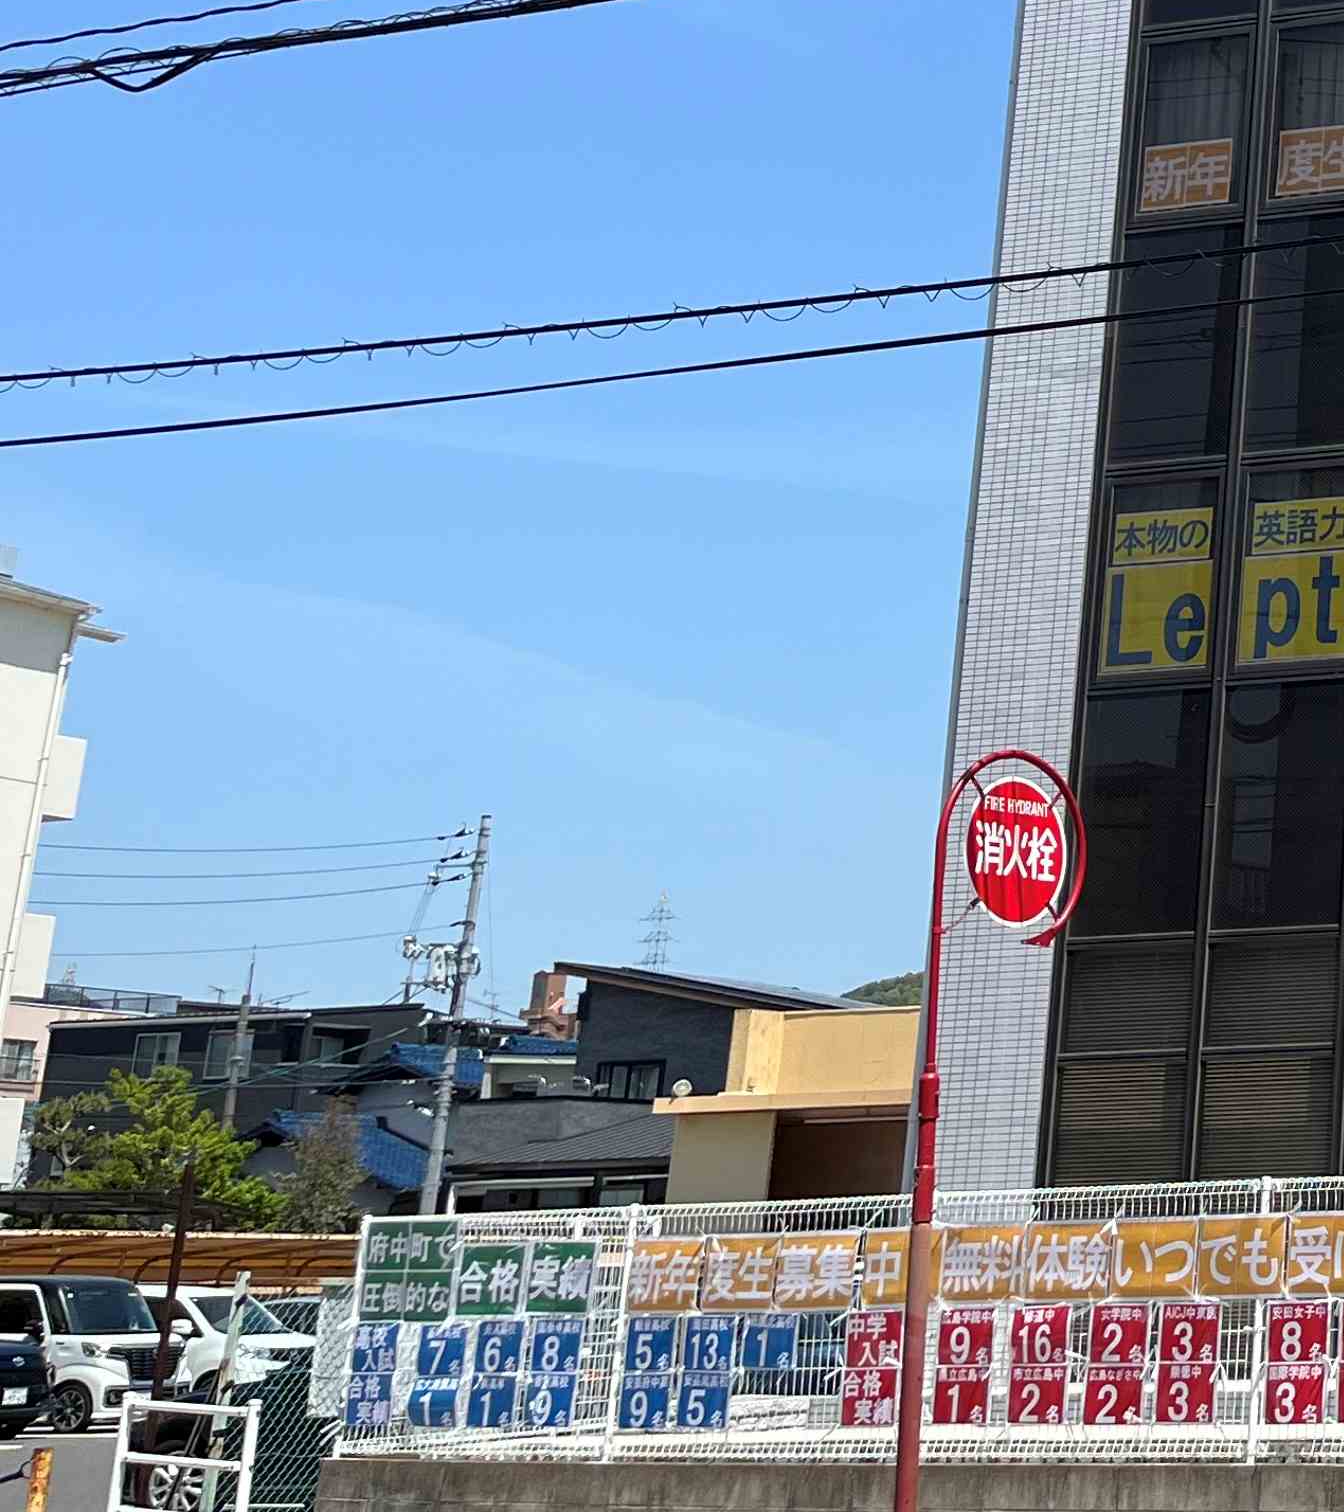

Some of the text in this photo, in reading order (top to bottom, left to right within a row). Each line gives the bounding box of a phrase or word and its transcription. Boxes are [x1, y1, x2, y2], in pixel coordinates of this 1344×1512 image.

[984, 795, 1050, 818] FIRE HYDRANT
[975, 819, 1058, 882] 消火栓
[459, 1254, 593, 1304] 合格実績
[849, 1312, 887, 1339] 中学
[1272, 1305, 1327, 1320] 安田女子中
[361, 1349, 394, 1372] 入試
[349, 1375, 380, 1400] 合格
[843, 1369, 882, 1397] 合格
[356, 1400, 390, 1425] 実績
[854, 1398, 894, 1426] 実績
